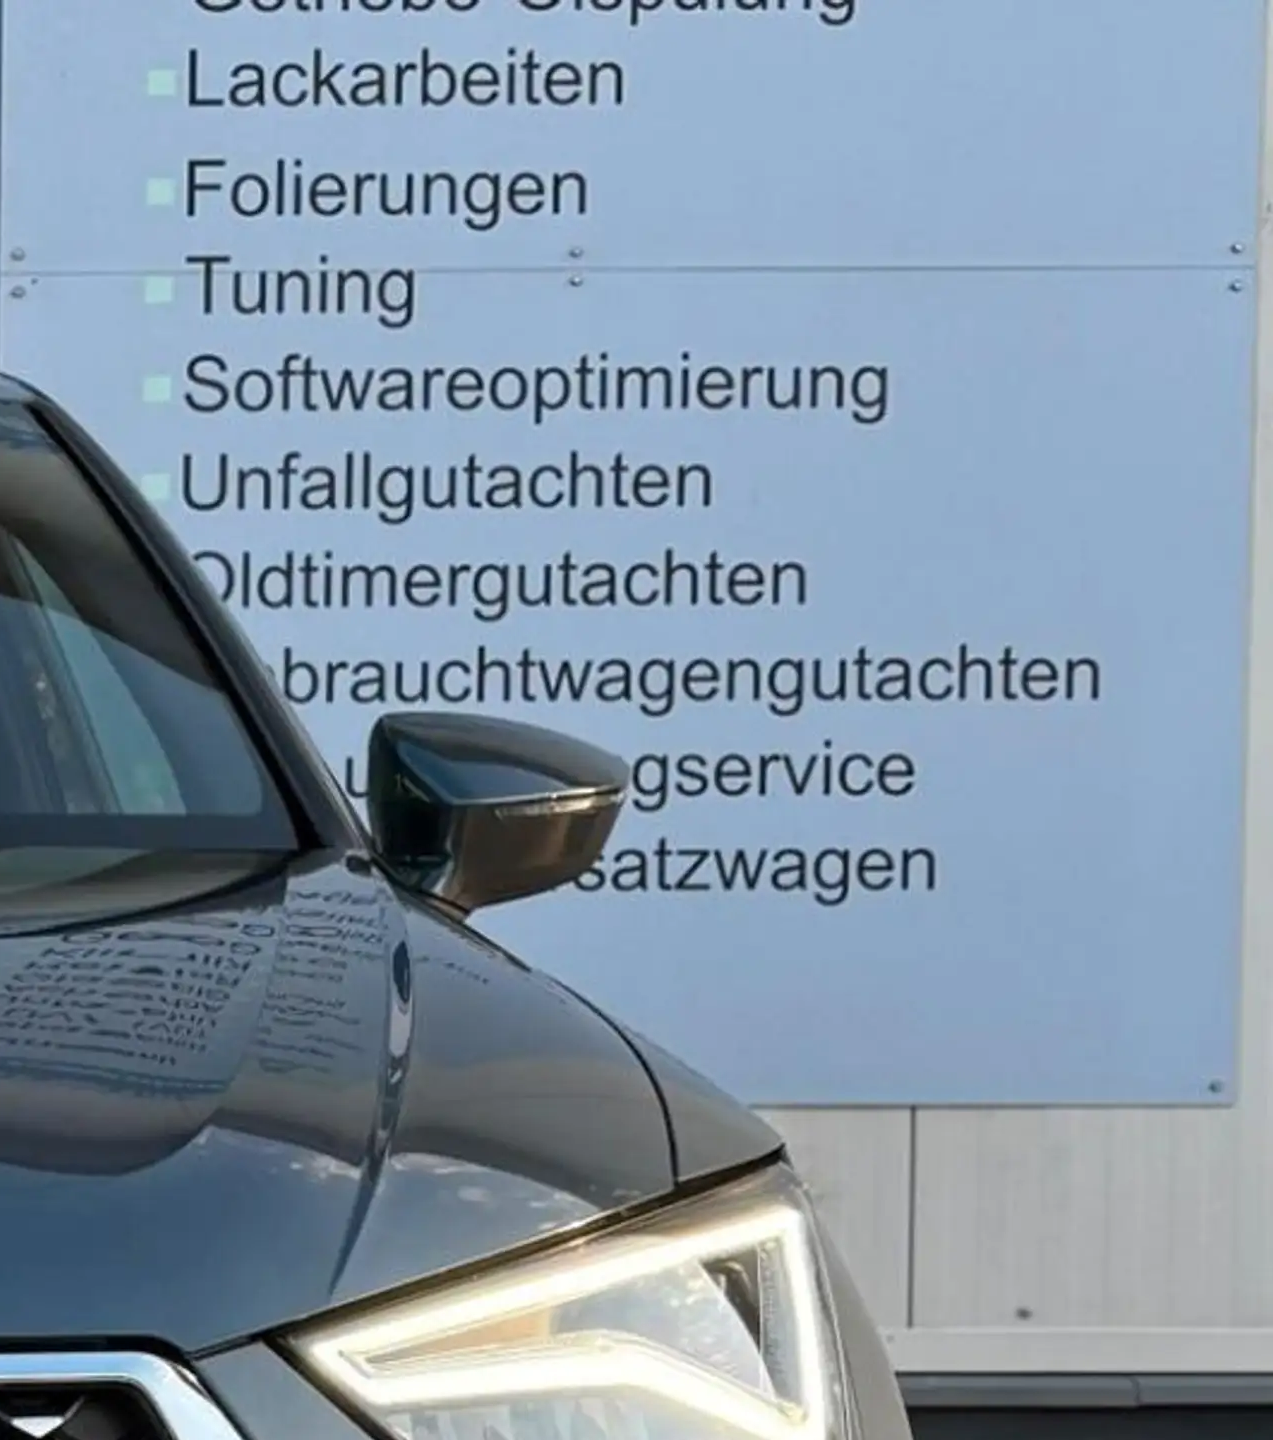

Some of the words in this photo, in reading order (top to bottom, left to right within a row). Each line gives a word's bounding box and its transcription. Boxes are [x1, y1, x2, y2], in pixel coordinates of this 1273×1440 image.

[187, 48, 623, 108] Lackarbeiten
[185, 159, 587, 231] Folierungen
[186, 256, 417, 328] Tuning
[184, 352, 889, 424] Softwareoptimierung
[181, 451, 713, 525] Unfallgutachten
[281, 645, 1101, 715] brauchtwagengutachten
[631, 740, 917, 812] gservice
[573, 836, 938, 905] satzwagen
